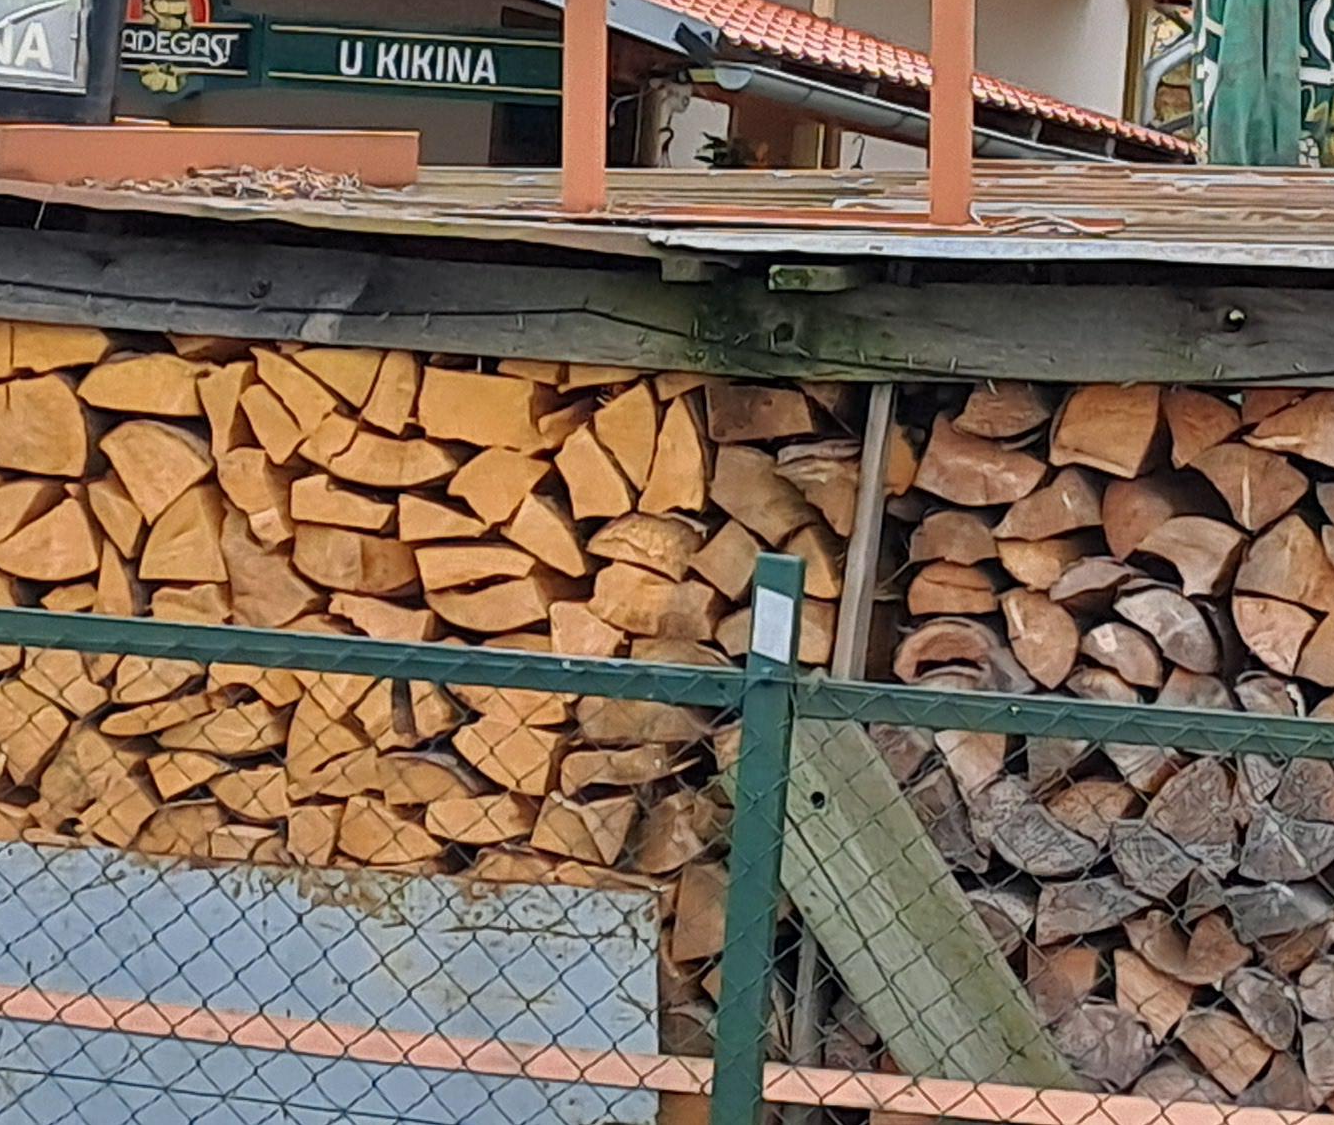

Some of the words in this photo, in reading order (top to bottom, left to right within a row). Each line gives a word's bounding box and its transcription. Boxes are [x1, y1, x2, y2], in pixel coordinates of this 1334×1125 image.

[120, 28, 240, 66] ADEGAST
[339, 39, 364, 75] U
[376, 42, 497, 84] KIKINA
